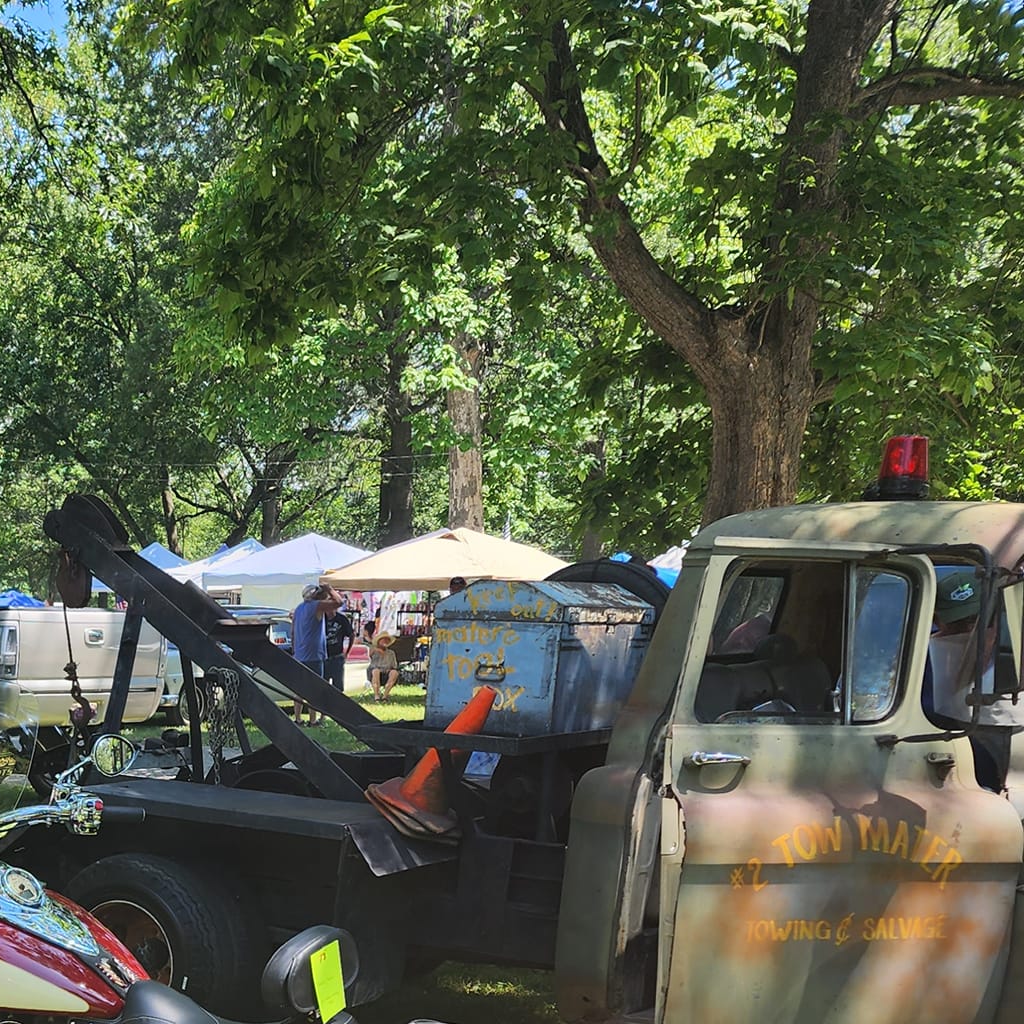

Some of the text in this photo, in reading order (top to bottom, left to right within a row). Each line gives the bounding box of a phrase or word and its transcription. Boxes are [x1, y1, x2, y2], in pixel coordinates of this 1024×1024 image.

[771, 815, 842, 869] TOW
[856, 814, 964, 890] MATER
[745, 919, 831, 943] TOWING
[862, 915, 949, 941] SALVAGE
